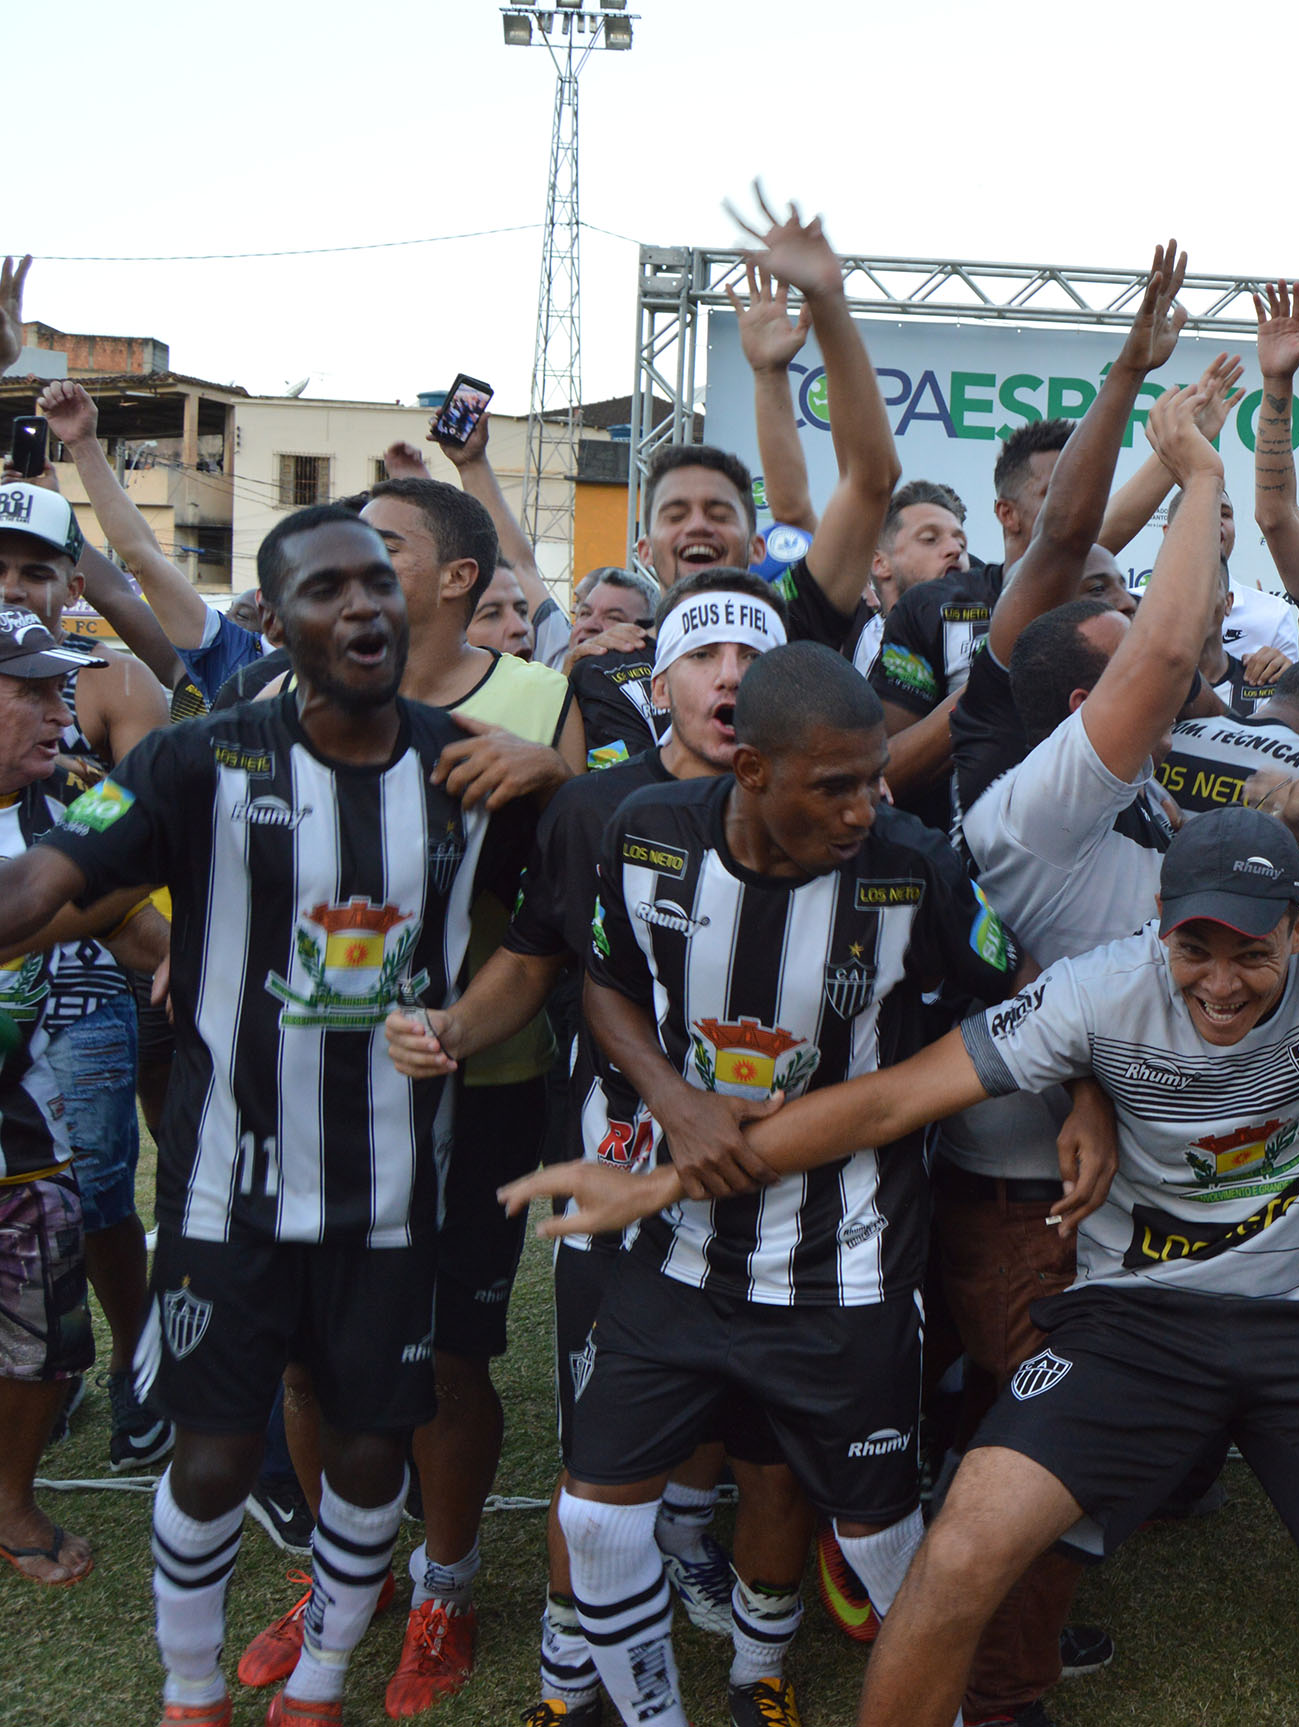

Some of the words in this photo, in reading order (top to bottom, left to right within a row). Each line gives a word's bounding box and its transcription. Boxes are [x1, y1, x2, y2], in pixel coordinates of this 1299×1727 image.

[75, 620, 98, 634] FC
[681, 604, 720, 636] DEUS
[724, 599, 735, 625] É
[739, 605, 769, 636] FIEL
[1243, 689, 1258, 698] LOS
[623, 842, 648, 861] LOS
[649, 851, 684, 871] NETO
[1232, 859, 1283, 881] Rhumy
[860, 887, 888, 903] LOS
[889, 886, 921, 902] NETO
[635, 900, 701, 938] Rhumy
[1124, 1062, 1194, 1091] Rhumy
[239, 1129, 281, 1196] 11
[847, 1431, 911, 1457] Rhumy
